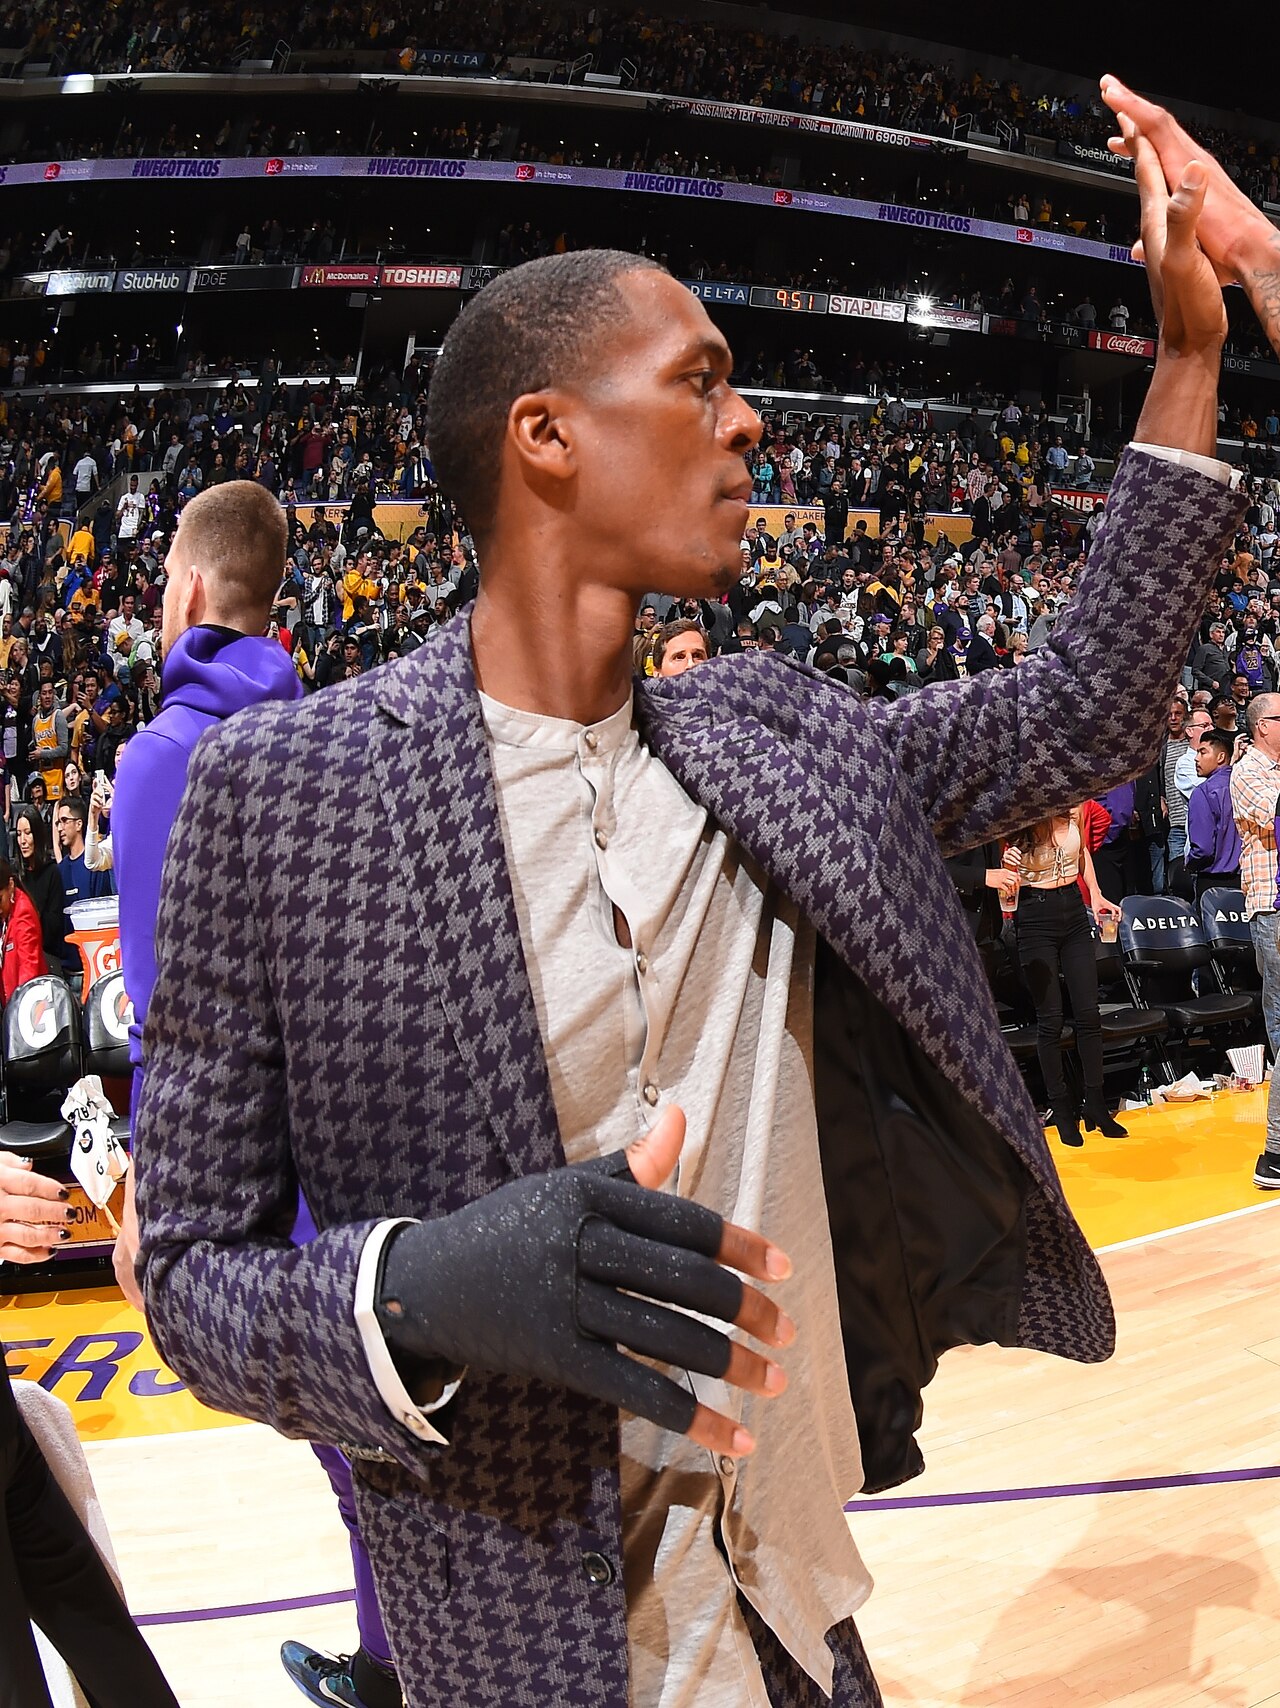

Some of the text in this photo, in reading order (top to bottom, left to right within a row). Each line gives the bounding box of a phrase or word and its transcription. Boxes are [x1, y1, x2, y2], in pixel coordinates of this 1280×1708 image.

[739, 109, 756, 122] TEXT
[832, 123, 865, 140] LOCATION
[875, 131, 911, 147] 69050
[132, 160, 221, 177] #WEGOTTACOS
[367, 158, 466, 178] #WEGOTTACOS
[624, 172, 724, 199] #WEGOTTACOS
[878, 203, 971, 232] #WEGOTTACOS
[122, 273, 180, 289] StubHub
[383, 269, 461, 286] TOSHIBA
[691, 284, 746, 302] DELTA
[830, 296, 903, 320] STAPLES
[1147, 915, 1199, 930] DELTA
[18, 980, 58, 1049] G
